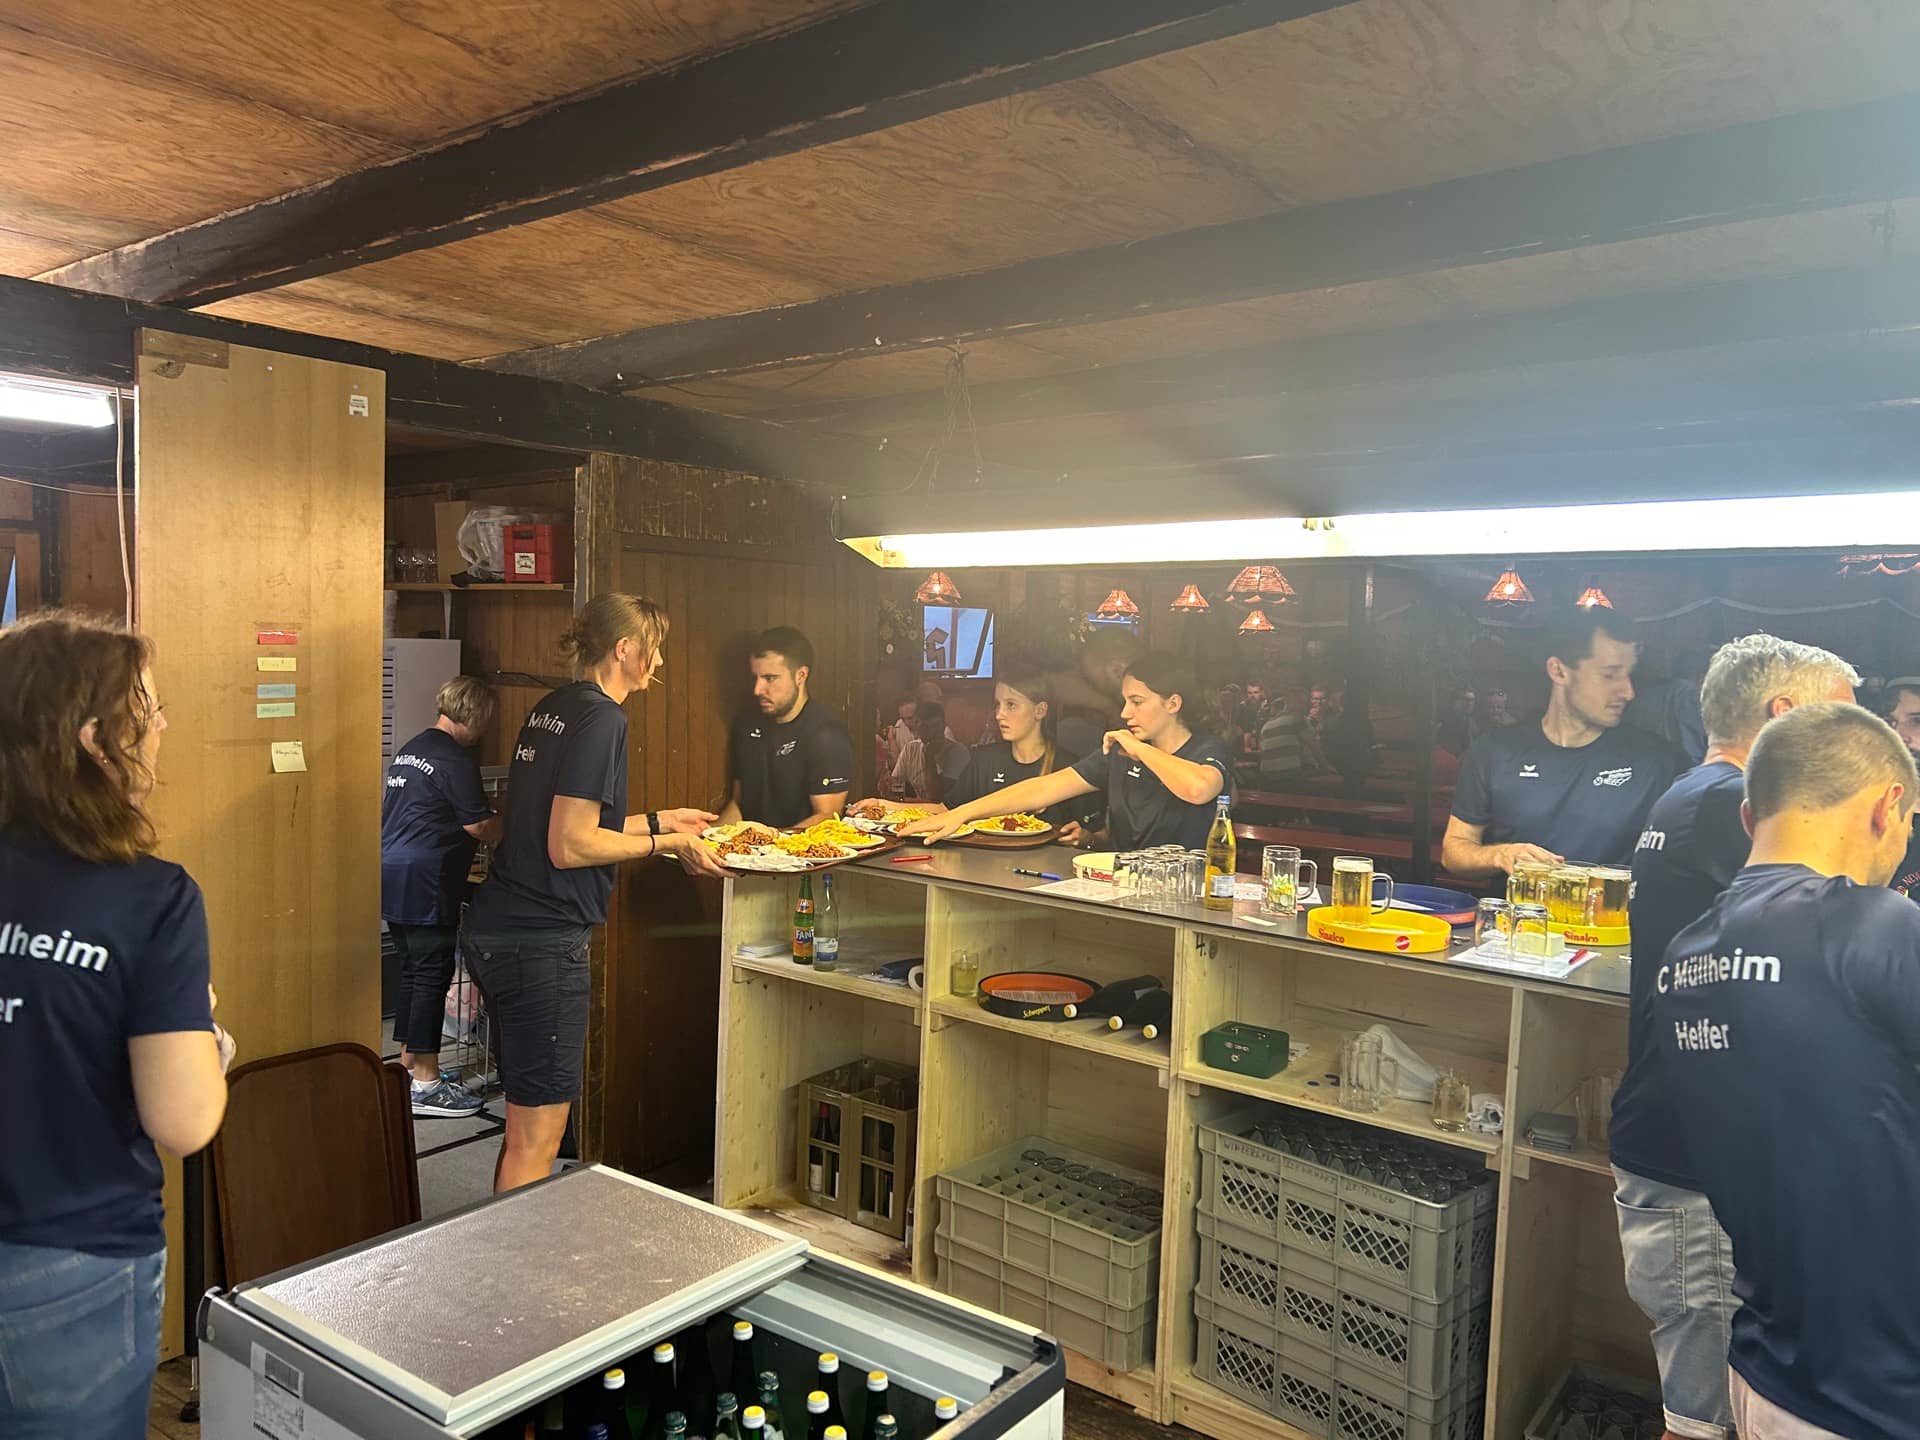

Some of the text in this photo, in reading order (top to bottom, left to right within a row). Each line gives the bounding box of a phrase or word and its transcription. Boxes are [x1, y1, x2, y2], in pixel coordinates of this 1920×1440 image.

[1657, 948, 1781, 993] C Müllheim
[1675, 1018, 1729, 1050] Helfer
